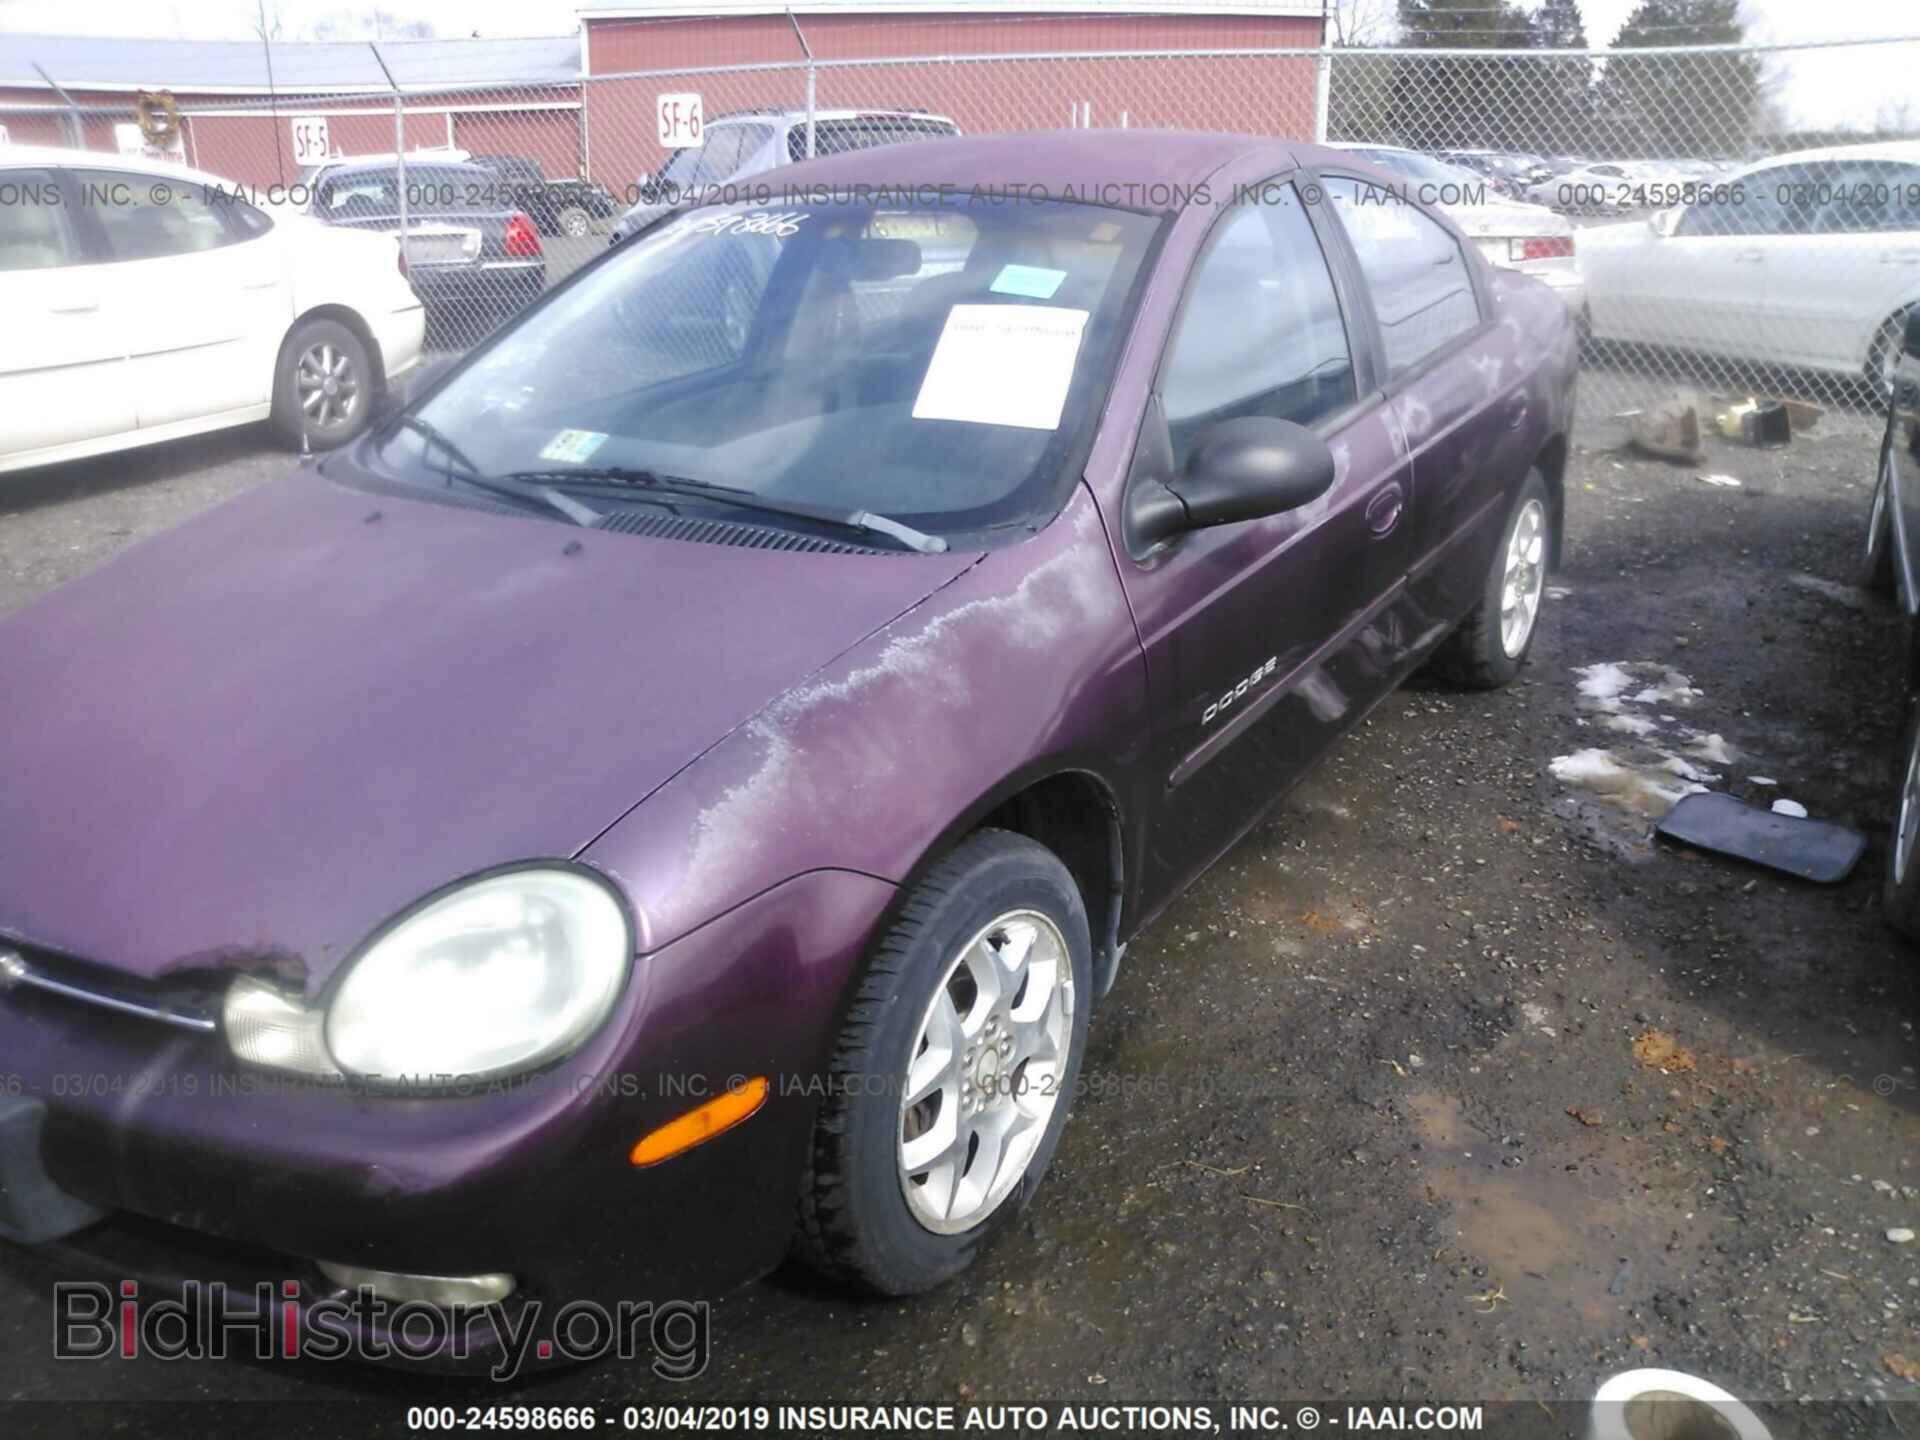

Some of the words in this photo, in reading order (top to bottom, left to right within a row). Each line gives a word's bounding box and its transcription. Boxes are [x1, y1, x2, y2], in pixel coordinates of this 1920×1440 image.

[661, 102, 700, 138] SF-6
[296, 125, 327, 157] SF-5
[1201, 656, 1278, 725] DODGE
